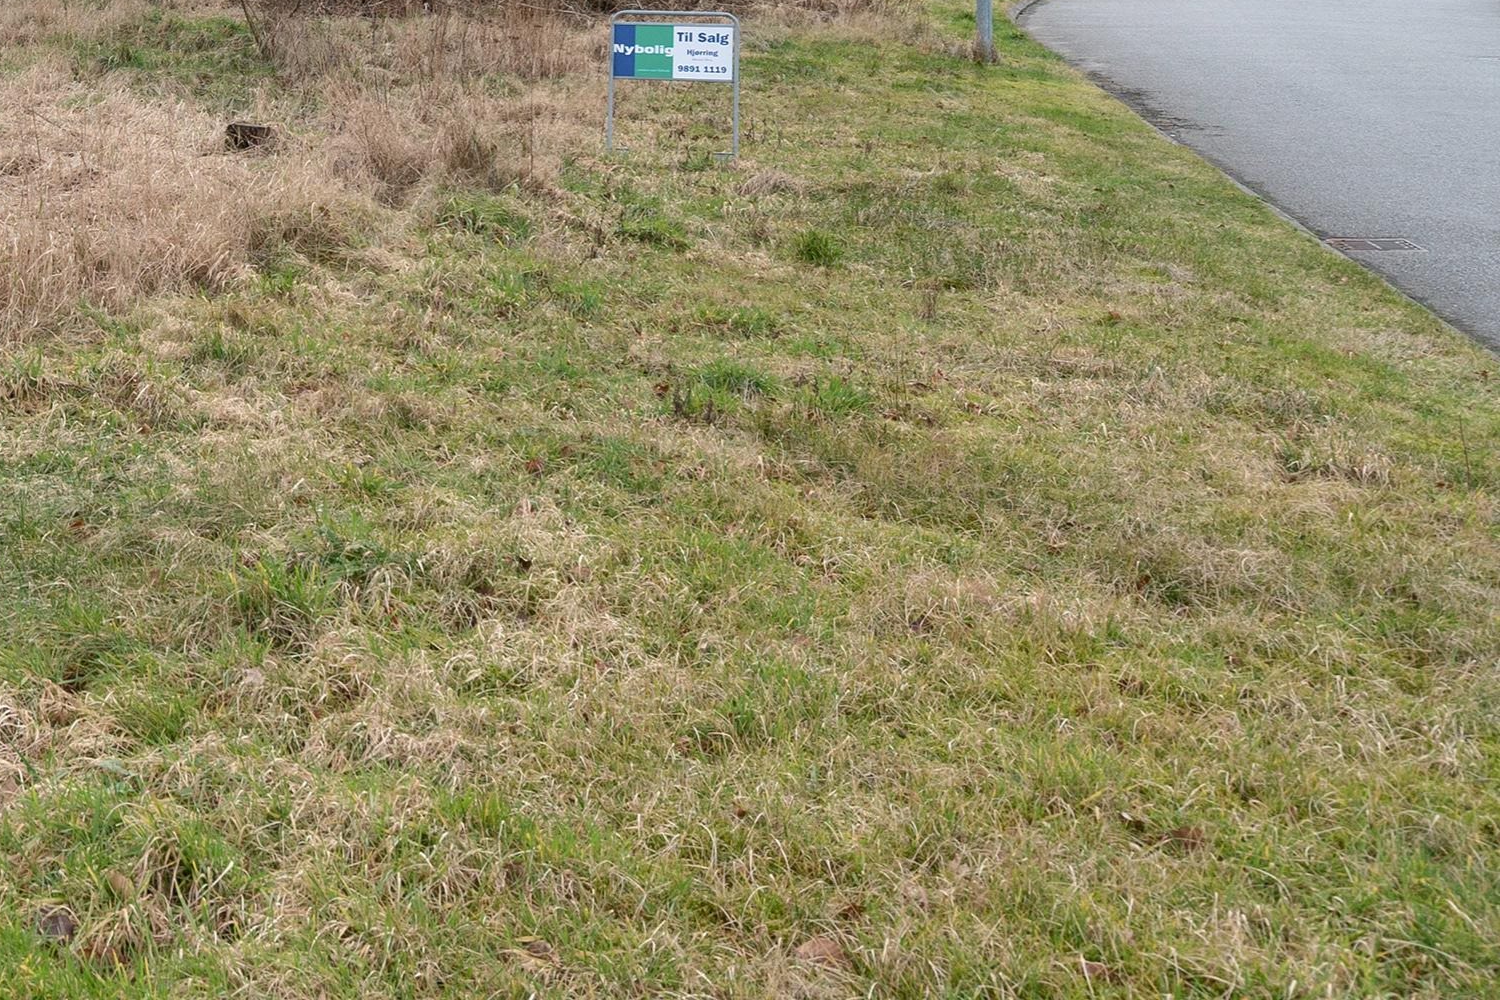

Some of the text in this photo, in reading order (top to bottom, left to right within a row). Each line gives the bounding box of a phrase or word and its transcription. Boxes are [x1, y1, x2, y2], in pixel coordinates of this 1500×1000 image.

[677, 32, 730, 46] Til Salg
[613, 43, 674, 57] Nybolig
[687, 49, 718, 57] Hjørring
[678, 65, 700, 73] 9891
[704, 66, 727, 74] 1119
